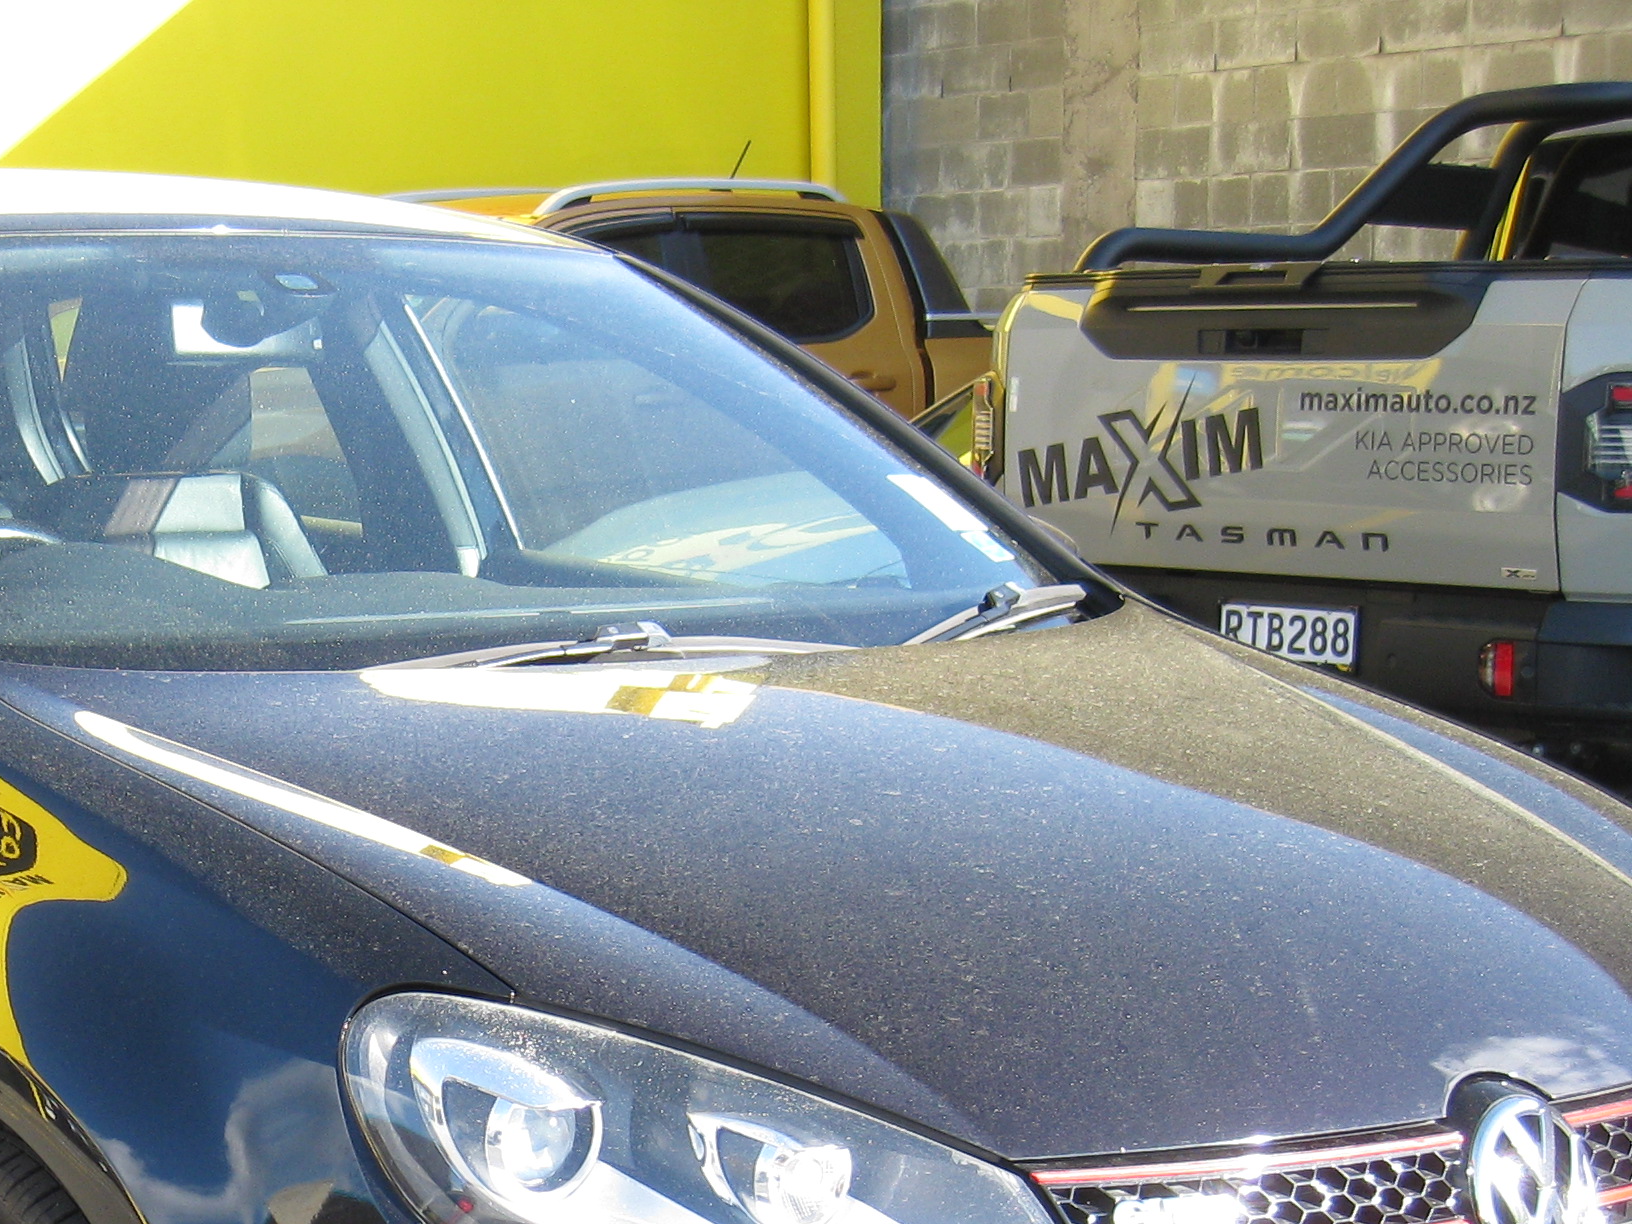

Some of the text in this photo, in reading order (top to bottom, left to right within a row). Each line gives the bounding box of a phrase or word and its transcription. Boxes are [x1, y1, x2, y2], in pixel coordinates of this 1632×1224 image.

[1299, 387, 1537, 415] maximauto.co.nz
[1018, 375, 1264, 538] MAXIM
[1355, 431, 1534, 455] KIA APPROVED
[1367, 459, 1533, 486] ACCESSORIES
[1135, 521, 1389, 552] TASMAN
[1224, 609, 1350, 657] RTB288
